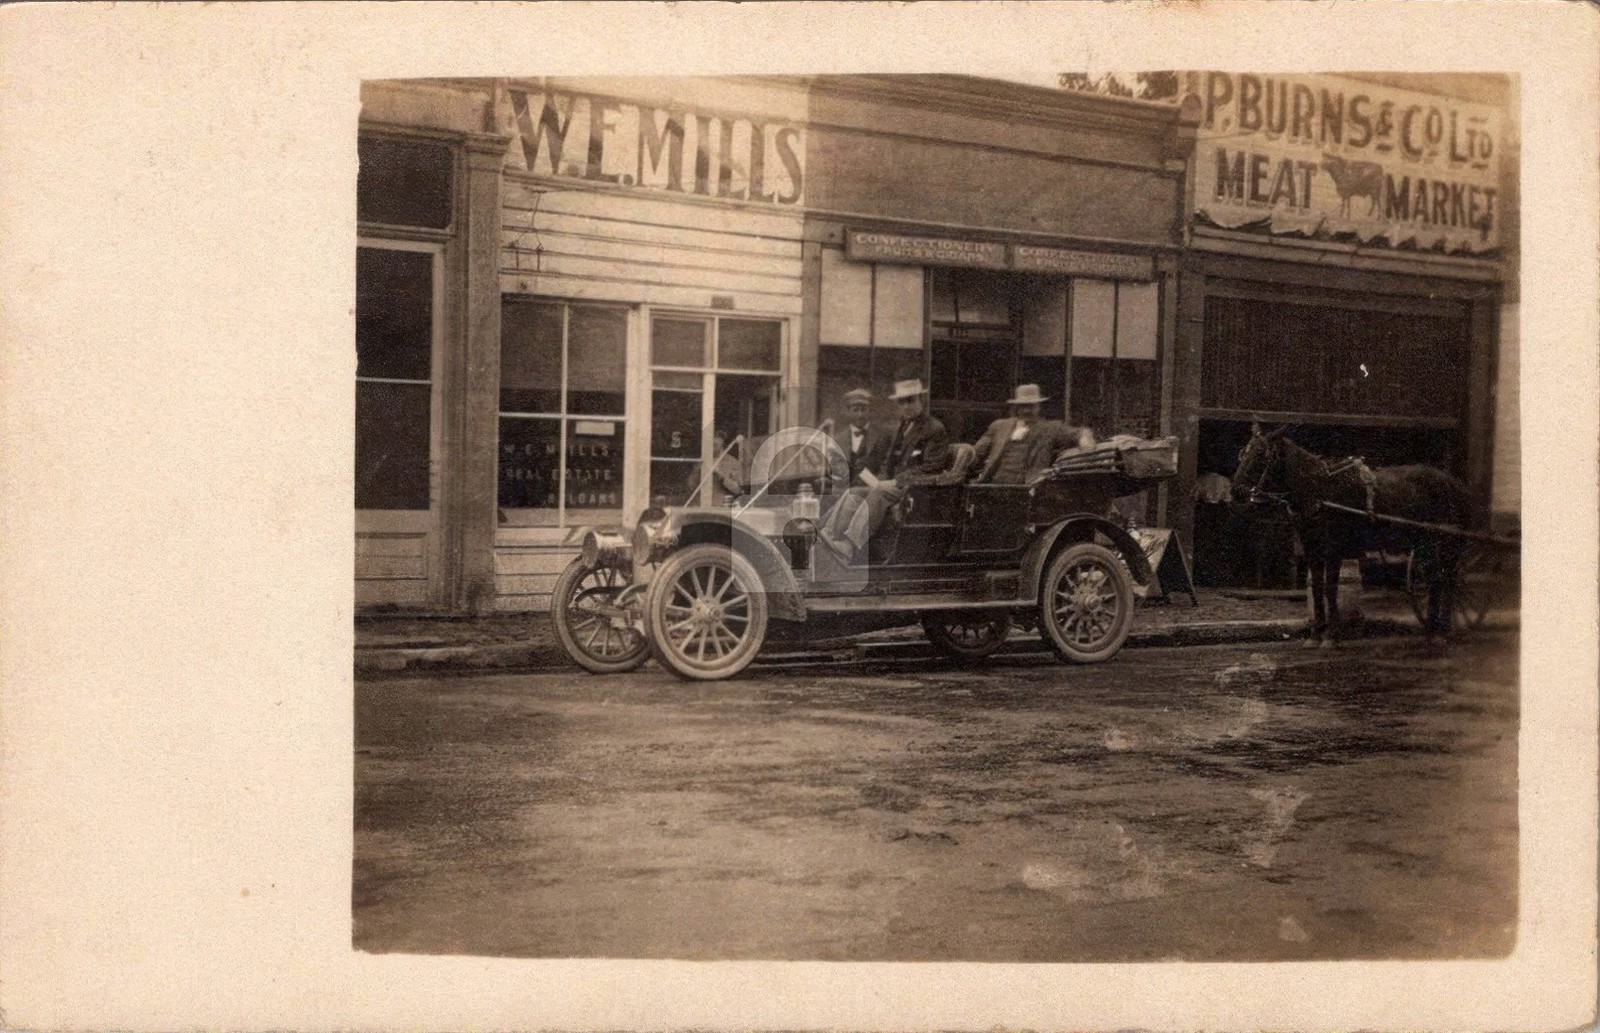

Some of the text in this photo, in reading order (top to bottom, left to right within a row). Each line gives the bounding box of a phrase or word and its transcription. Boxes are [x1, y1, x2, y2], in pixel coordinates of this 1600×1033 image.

[1238, 73, 1373, 148] BURNS
[1375, 101, 1395, 140] &
[637, 104, 802, 205] MILLS
[1214, 147, 1498, 232] MEAT MARKET
[569, 493, 616, 505] LOANS
